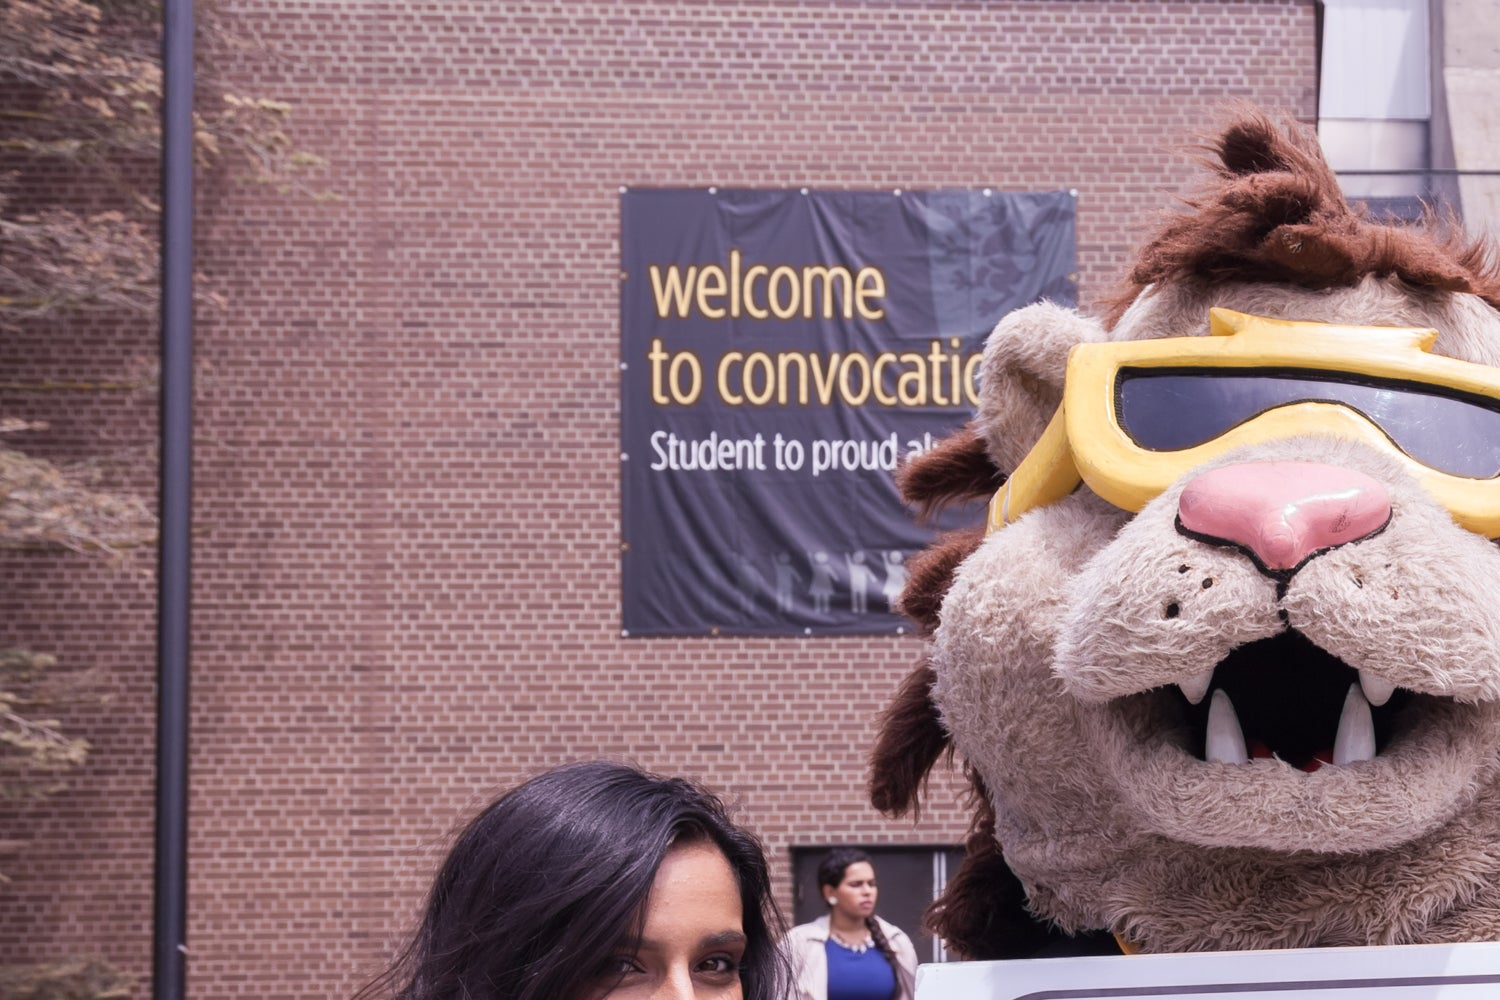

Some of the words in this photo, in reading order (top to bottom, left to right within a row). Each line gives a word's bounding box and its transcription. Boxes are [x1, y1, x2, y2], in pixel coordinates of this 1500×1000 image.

[649, 250, 886, 319] welcome
[648, 338, 702, 405] to
[717, 337, 984, 406] convocatio
[650, 430, 767, 471] Student
[774, 433, 805, 471] to
[812, 432, 898, 477] proud
[905, 431, 939, 464] al
